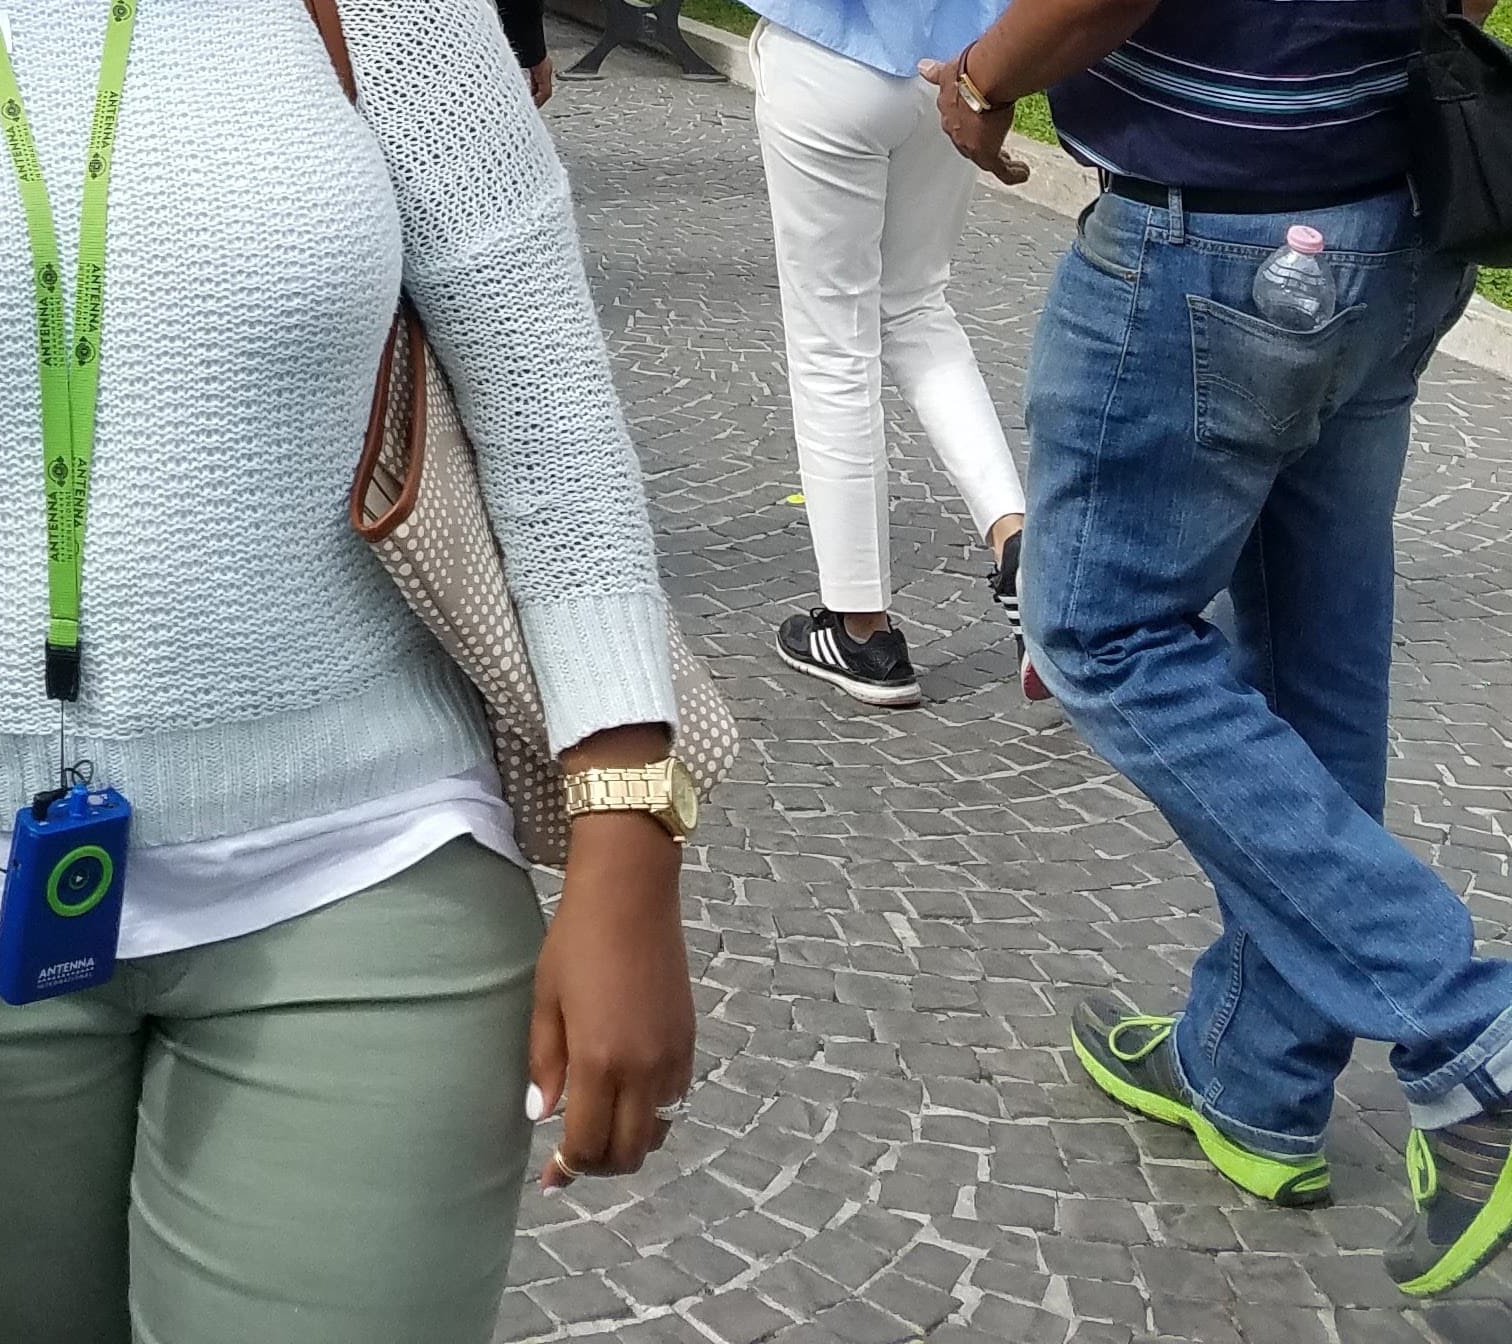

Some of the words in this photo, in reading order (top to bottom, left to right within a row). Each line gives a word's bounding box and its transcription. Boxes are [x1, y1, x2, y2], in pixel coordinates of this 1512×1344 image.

[5, 126, 30, 182] ANTENNA
[101, 90, 120, 149] ANTENNA
[38, 296, 52, 367] ANTENNA
[88, 263, 102, 333] ANTENNA
[47, 491, 60, 562] ANTENNA
[73, 456, 89, 529] ANTENNA
[39, 957, 95, 979] ANTENNA
